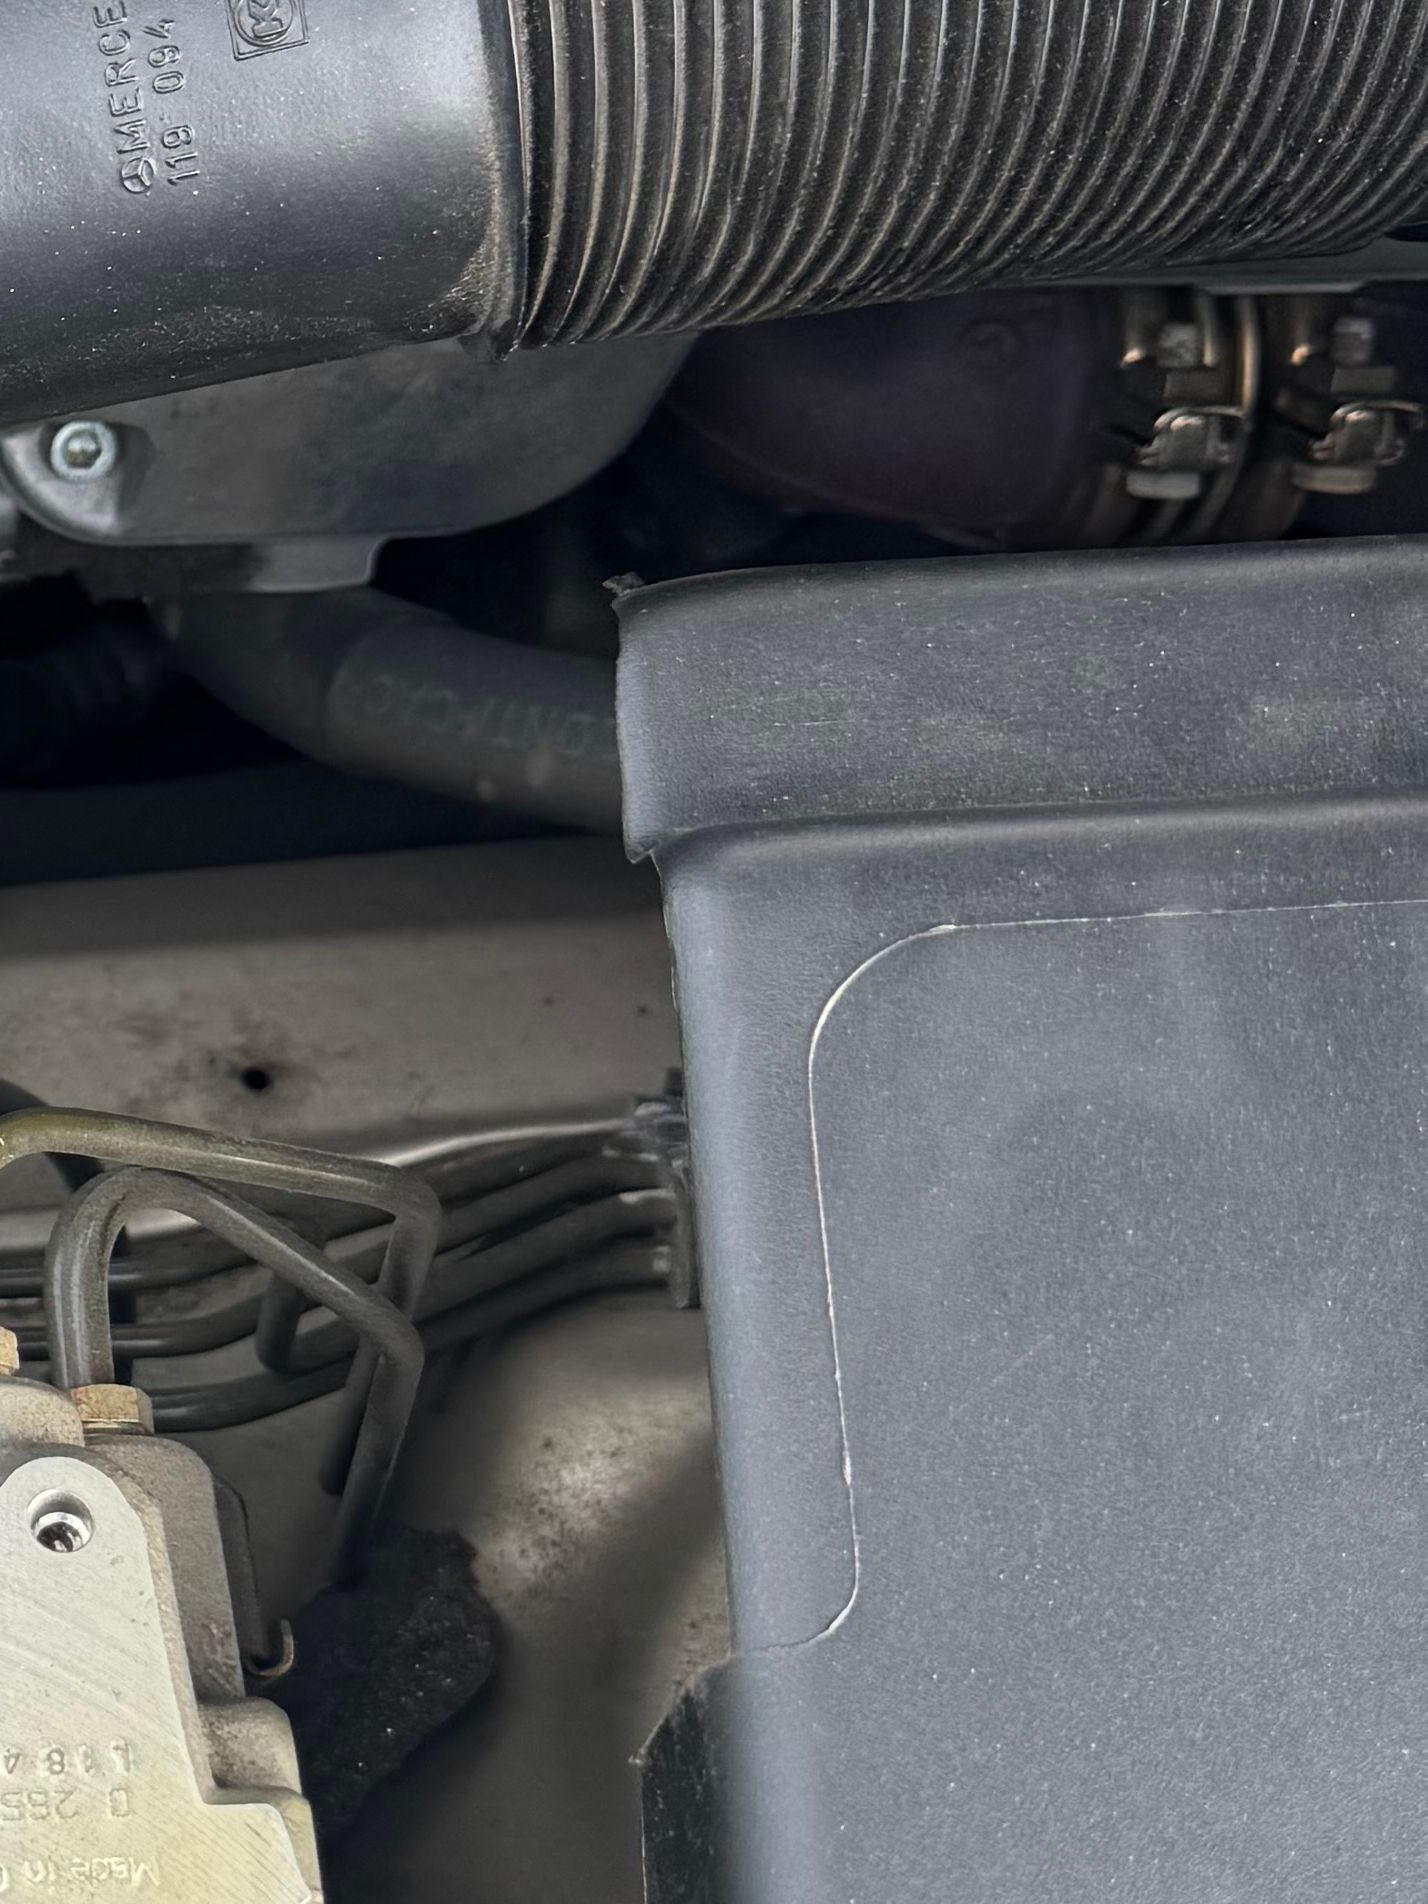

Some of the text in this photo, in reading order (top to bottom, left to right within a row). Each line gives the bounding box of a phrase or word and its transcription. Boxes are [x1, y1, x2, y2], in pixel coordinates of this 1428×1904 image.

[144, 18, 185, 95] 094
[106, 1787, 132, 1818] 0
[22, 1859, 56, 1891] in
[70, 1857, 161, 1888] Made
